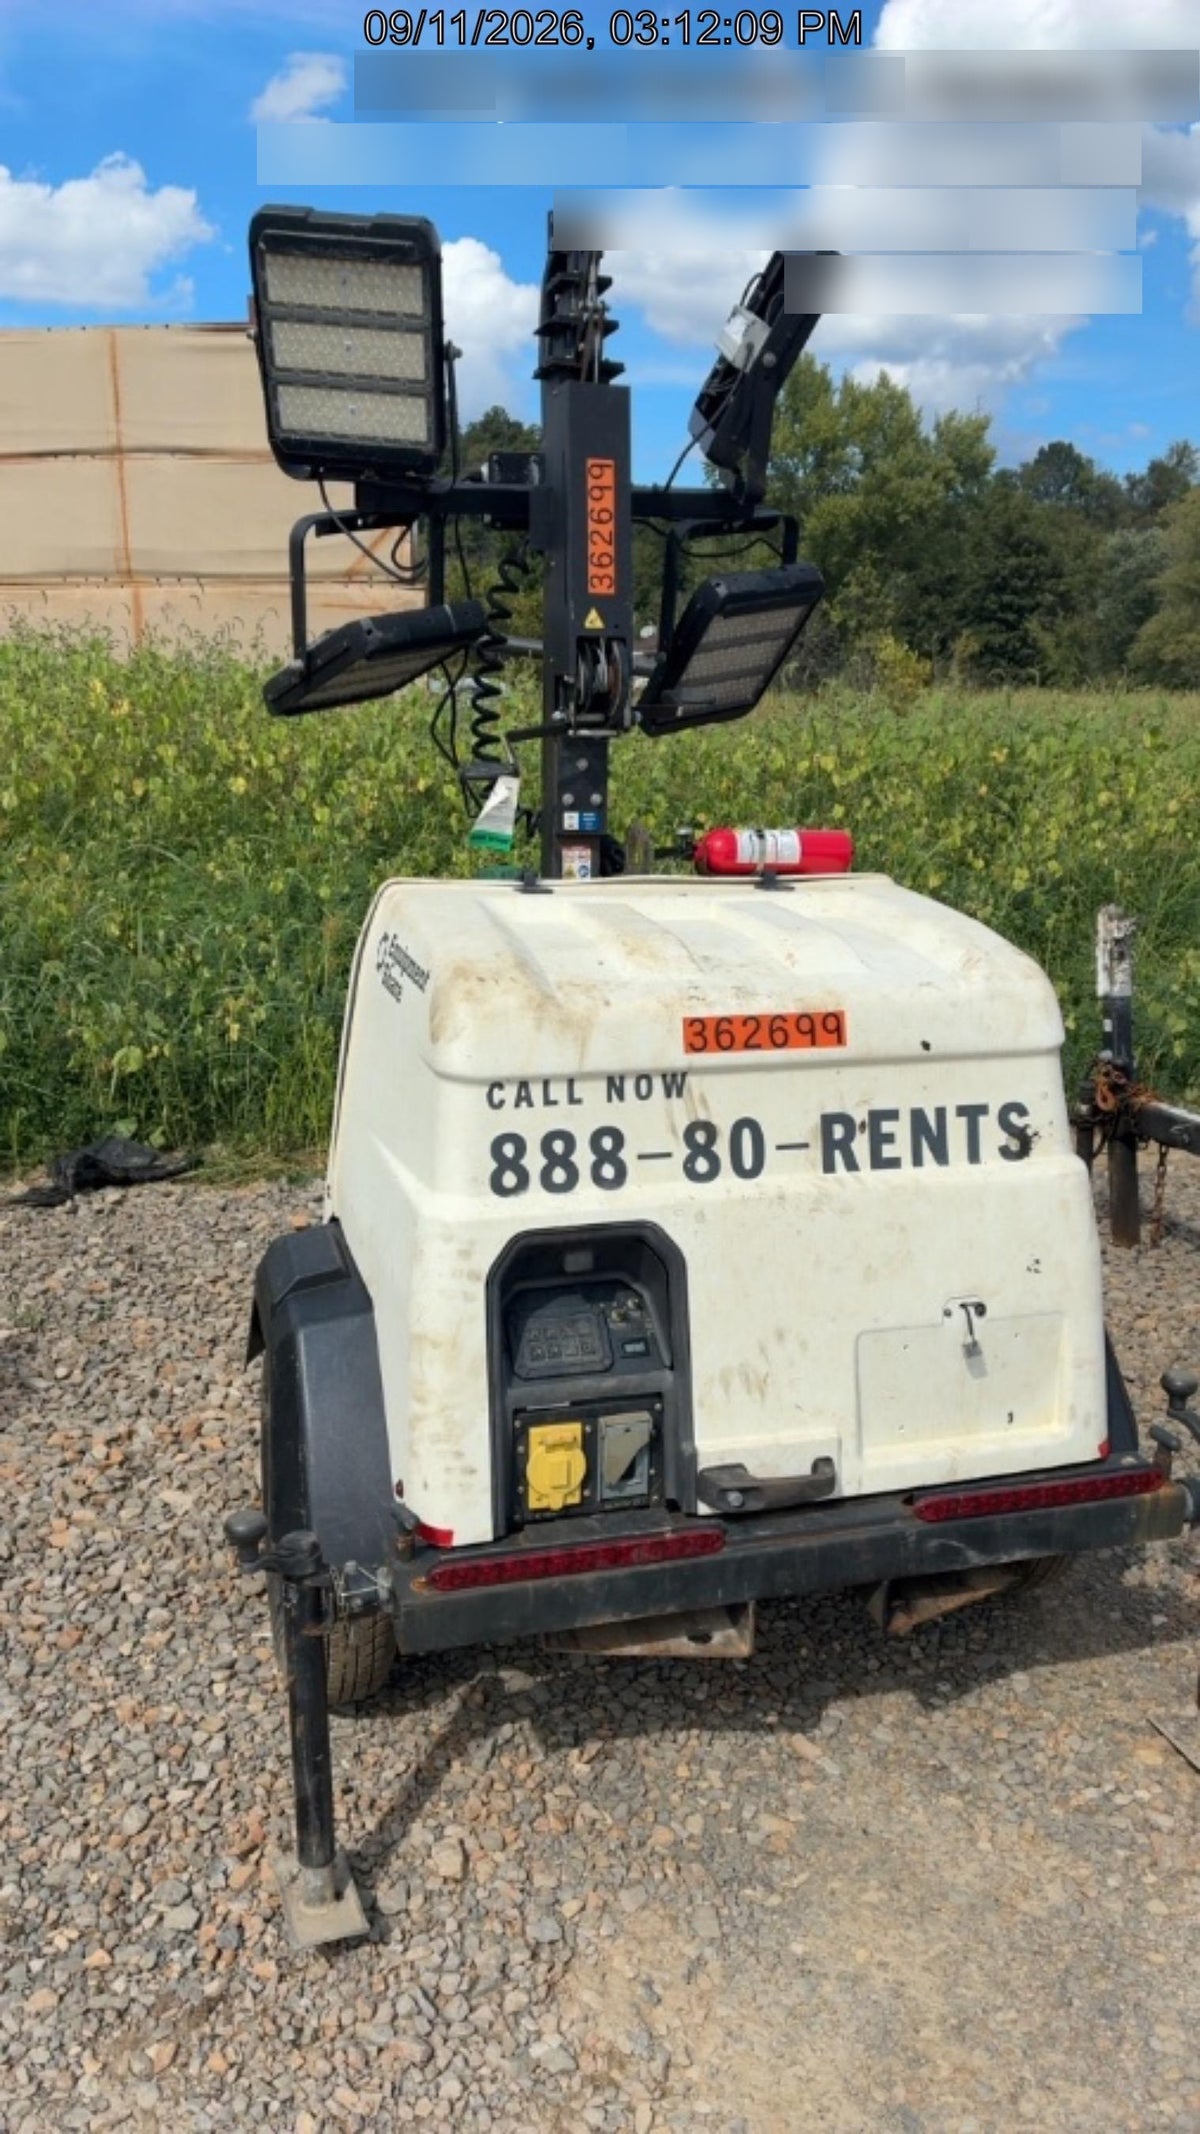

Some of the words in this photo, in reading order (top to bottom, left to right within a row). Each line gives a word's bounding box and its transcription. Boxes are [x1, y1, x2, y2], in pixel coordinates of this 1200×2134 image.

[589, 462, 613, 589] 362699
[687, 1012, 843, 1052] 362699
[486, 1078, 583, 1110] CALL
[606, 1071, 690, 1103] NOW
